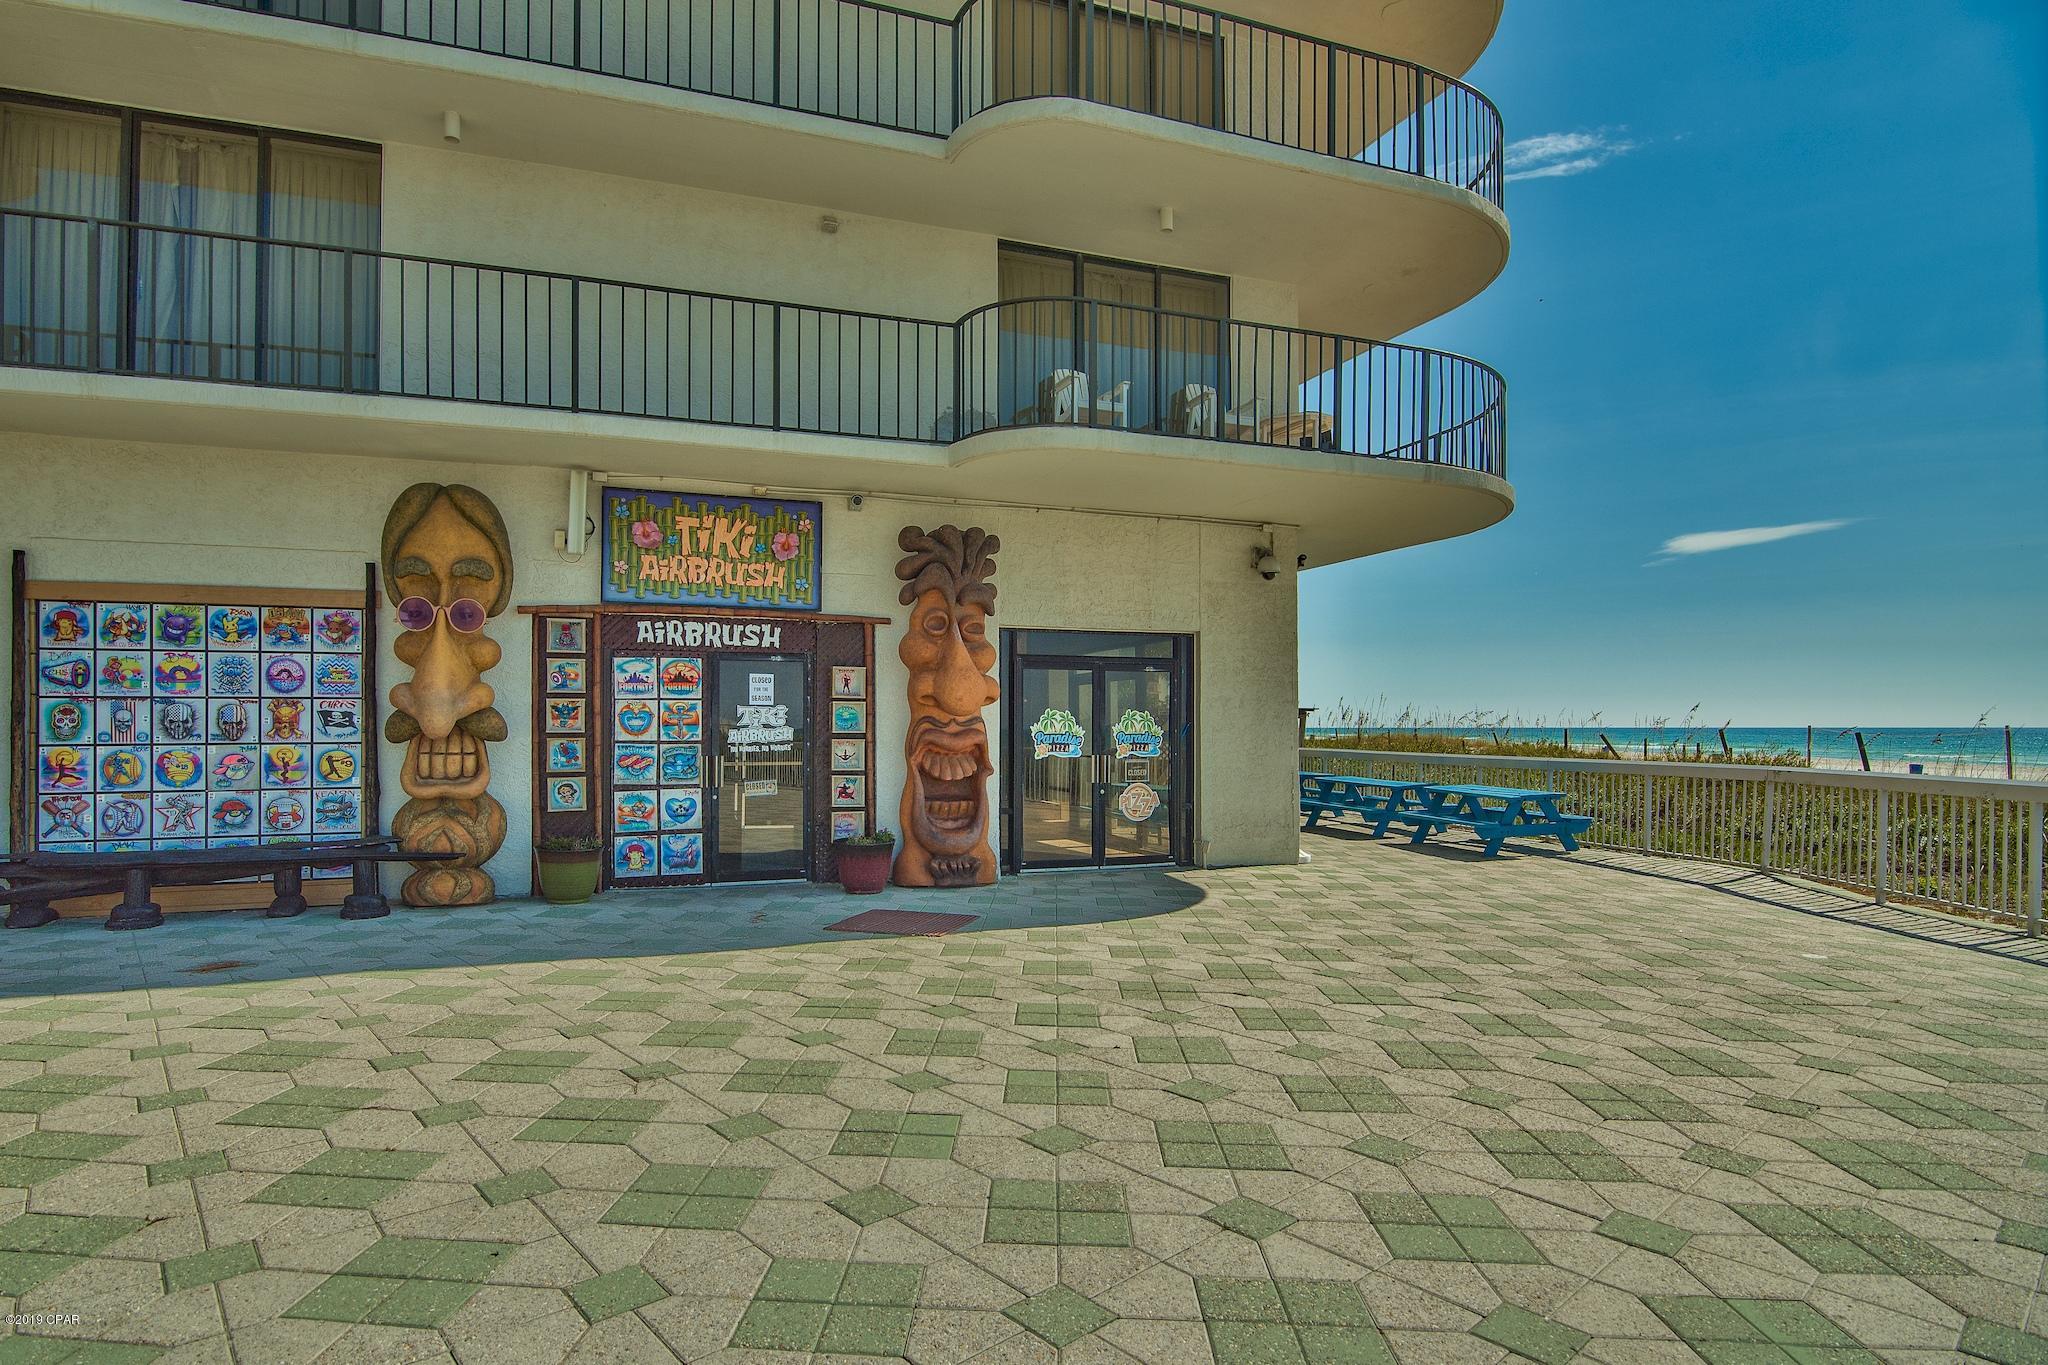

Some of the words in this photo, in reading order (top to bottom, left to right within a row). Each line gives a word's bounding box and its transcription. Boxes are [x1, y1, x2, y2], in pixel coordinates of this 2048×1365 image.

[751, 676, 772, 684] CLOSED
[1035, 731, 1082, 746] Paradise
[1116, 731, 1161, 746] Paradise
[1048, 744, 1069, 752] PIZZA
[1129, 744, 1149, 752] PIZZA
[745, 781, 766, 791] CLOSED
[1120, 791, 1159, 816] PIZZA
